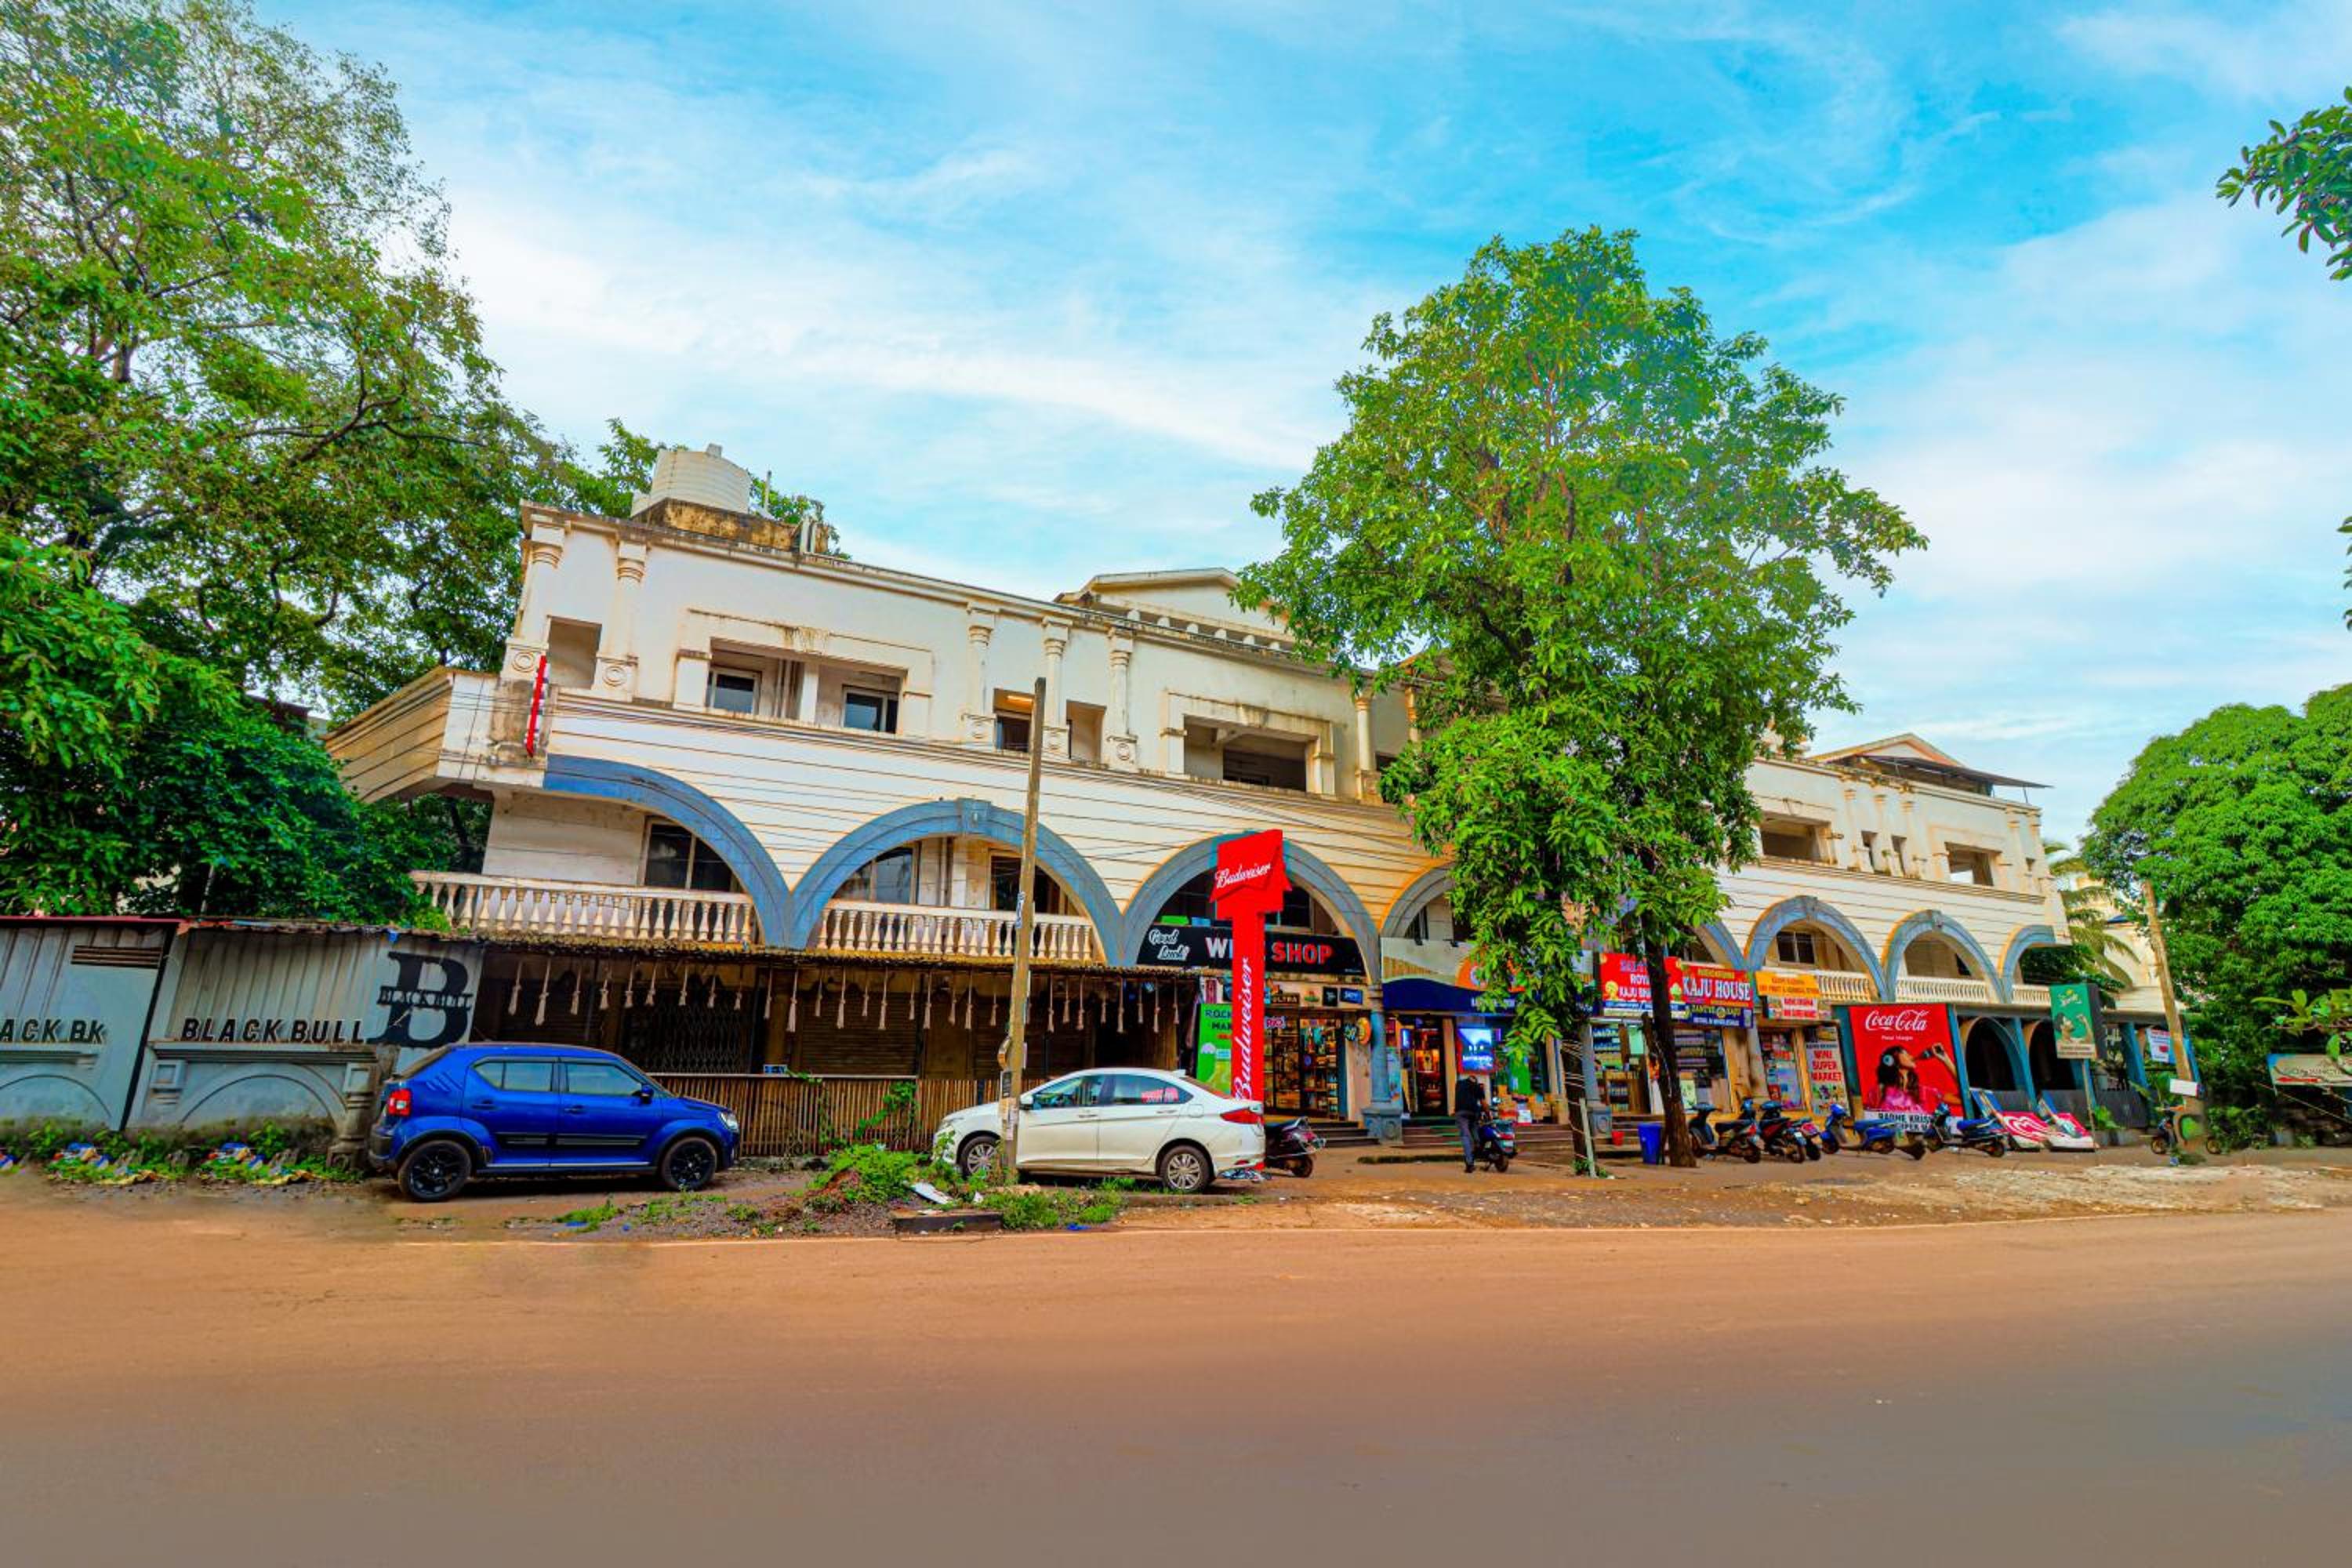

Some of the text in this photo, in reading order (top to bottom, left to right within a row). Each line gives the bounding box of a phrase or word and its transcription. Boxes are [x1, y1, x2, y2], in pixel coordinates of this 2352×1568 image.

[1215, 862, 1271, 888] Budweiser
[1272, 941, 1333, 964] SHOP
[1683, 976, 1712, 998] KAJU
[1715, 980, 1751, 1001] HOUSE
[181, 1018, 365, 1043] BLACK BULL
[1233, 957, 1252, 1101] Budweiser
